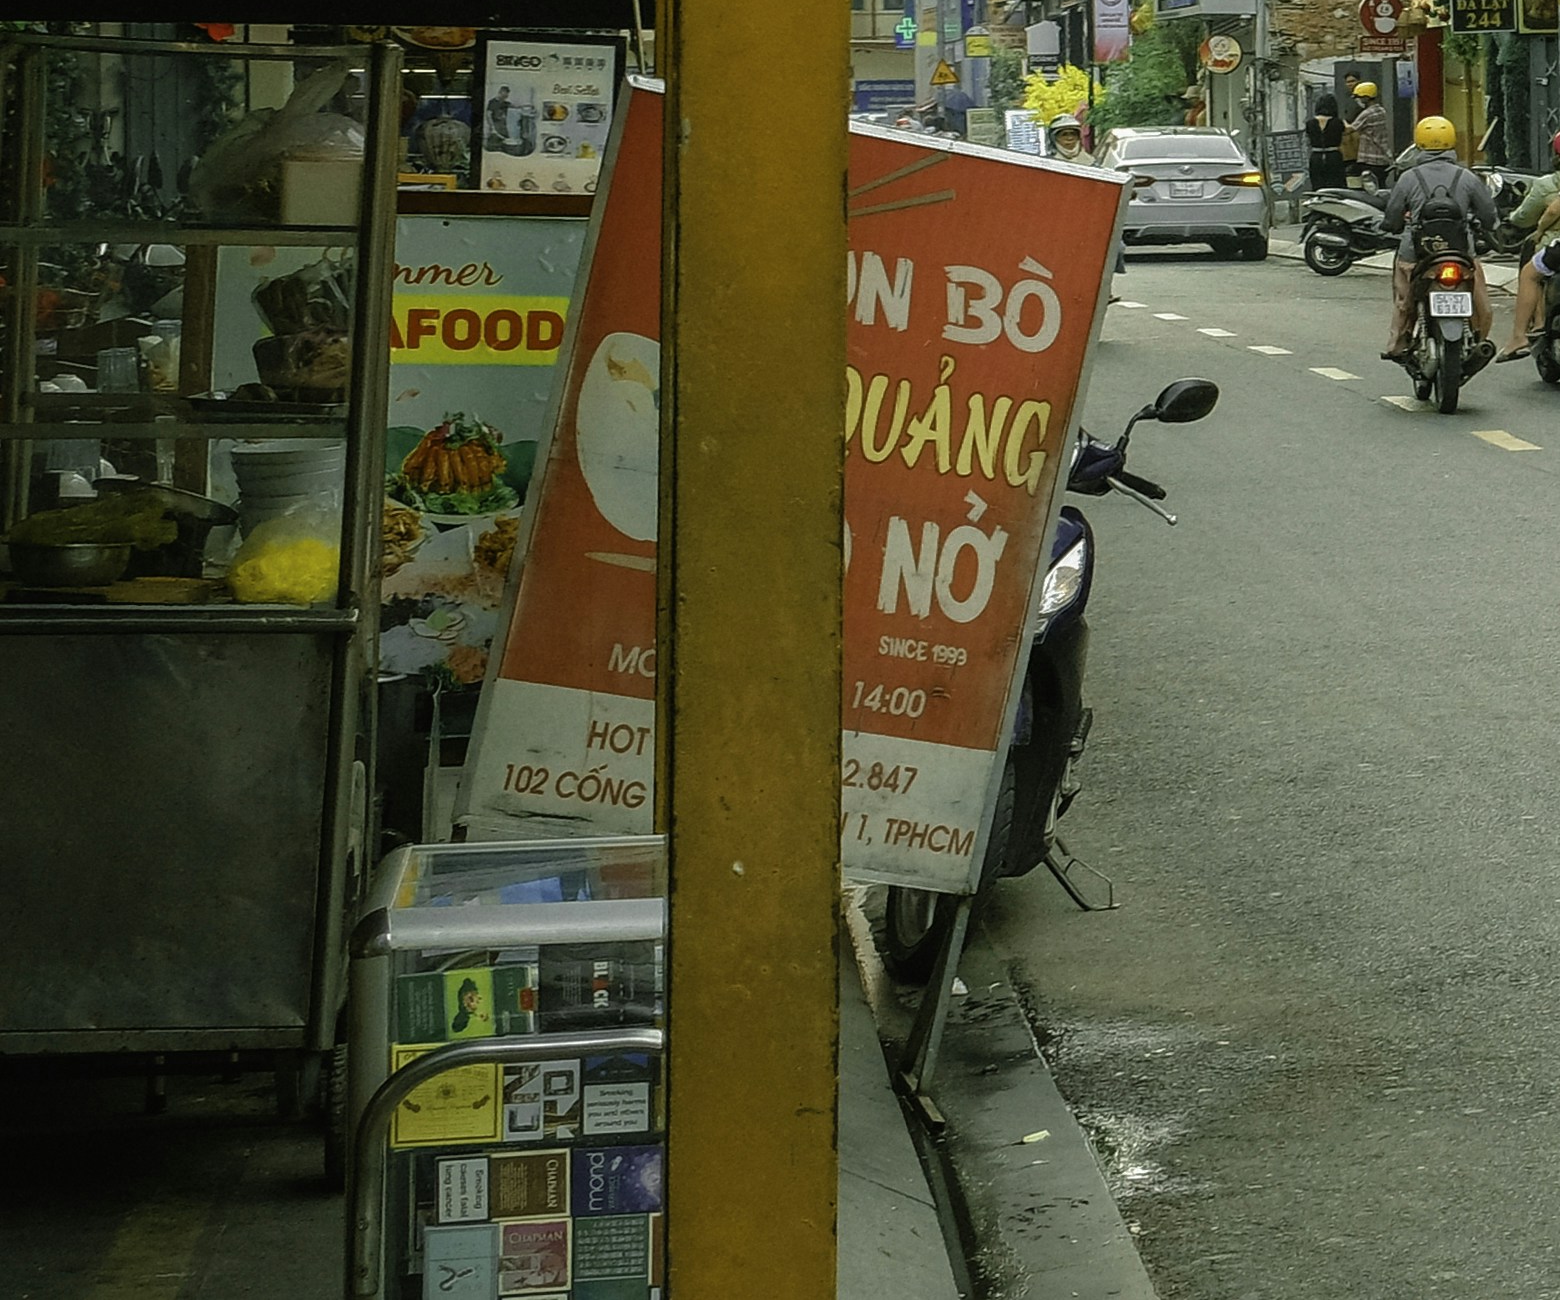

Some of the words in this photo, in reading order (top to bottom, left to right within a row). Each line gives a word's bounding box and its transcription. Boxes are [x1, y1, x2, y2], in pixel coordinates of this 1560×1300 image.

[1465, 11, 1503, 29] 244
[942, 255, 1061, 352] BÒ
[877, 490, 1008, 623] NỞ
[879, 635, 928, 663] SINCE
[931, 642, 968, 666] 1999
[850, 680, 927, 719] 14:00
[503, 763, 550, 796] 102
[555, 764, 648, 809] CỐNG
[884, 816, 974, 859] TPHCM
[508, 1231, 564, 1245] CHAPMAN
